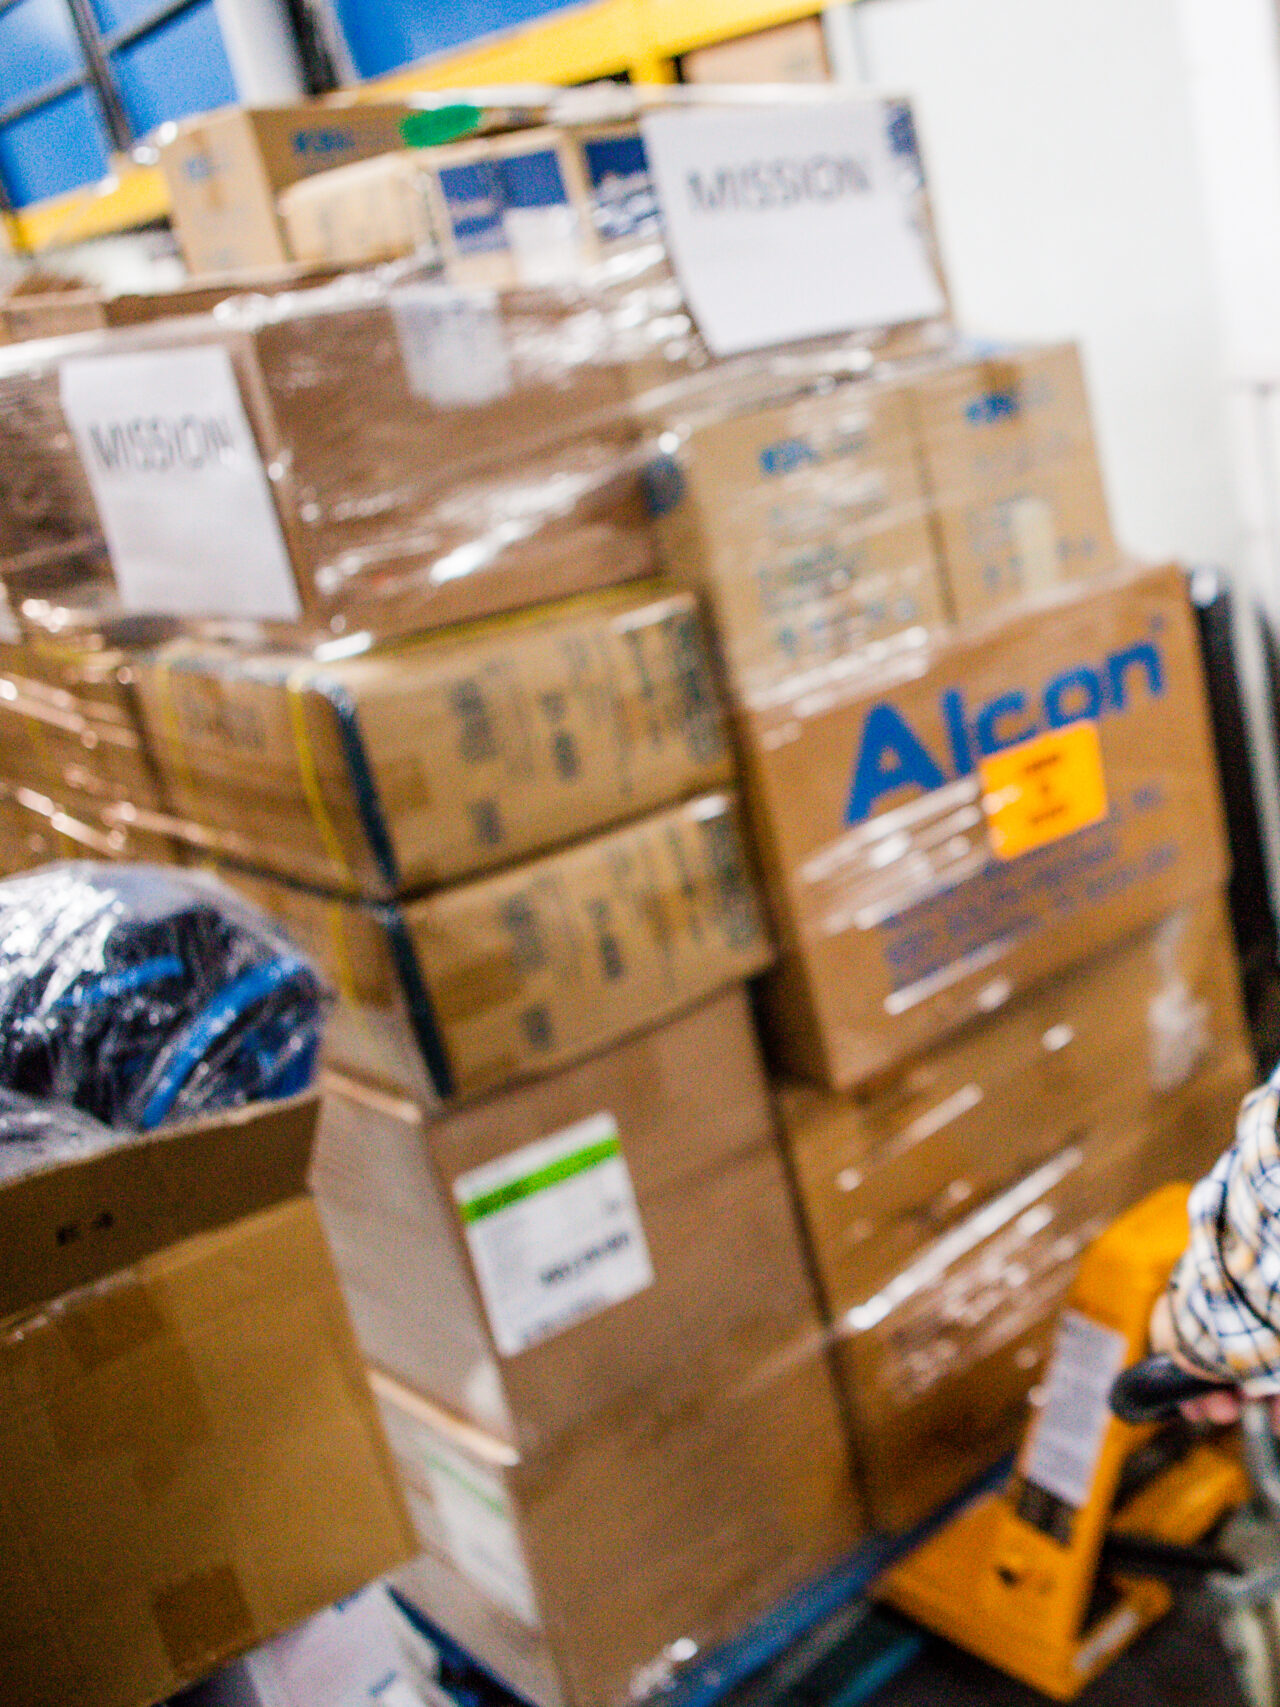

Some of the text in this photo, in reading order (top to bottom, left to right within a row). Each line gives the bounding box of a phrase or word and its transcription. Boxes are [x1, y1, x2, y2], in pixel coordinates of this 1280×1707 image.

[687, 155, 871, 211] MISSION
[90, 415, 237, 471] MISSION
[843, 639, 1167, 826] Alcon
